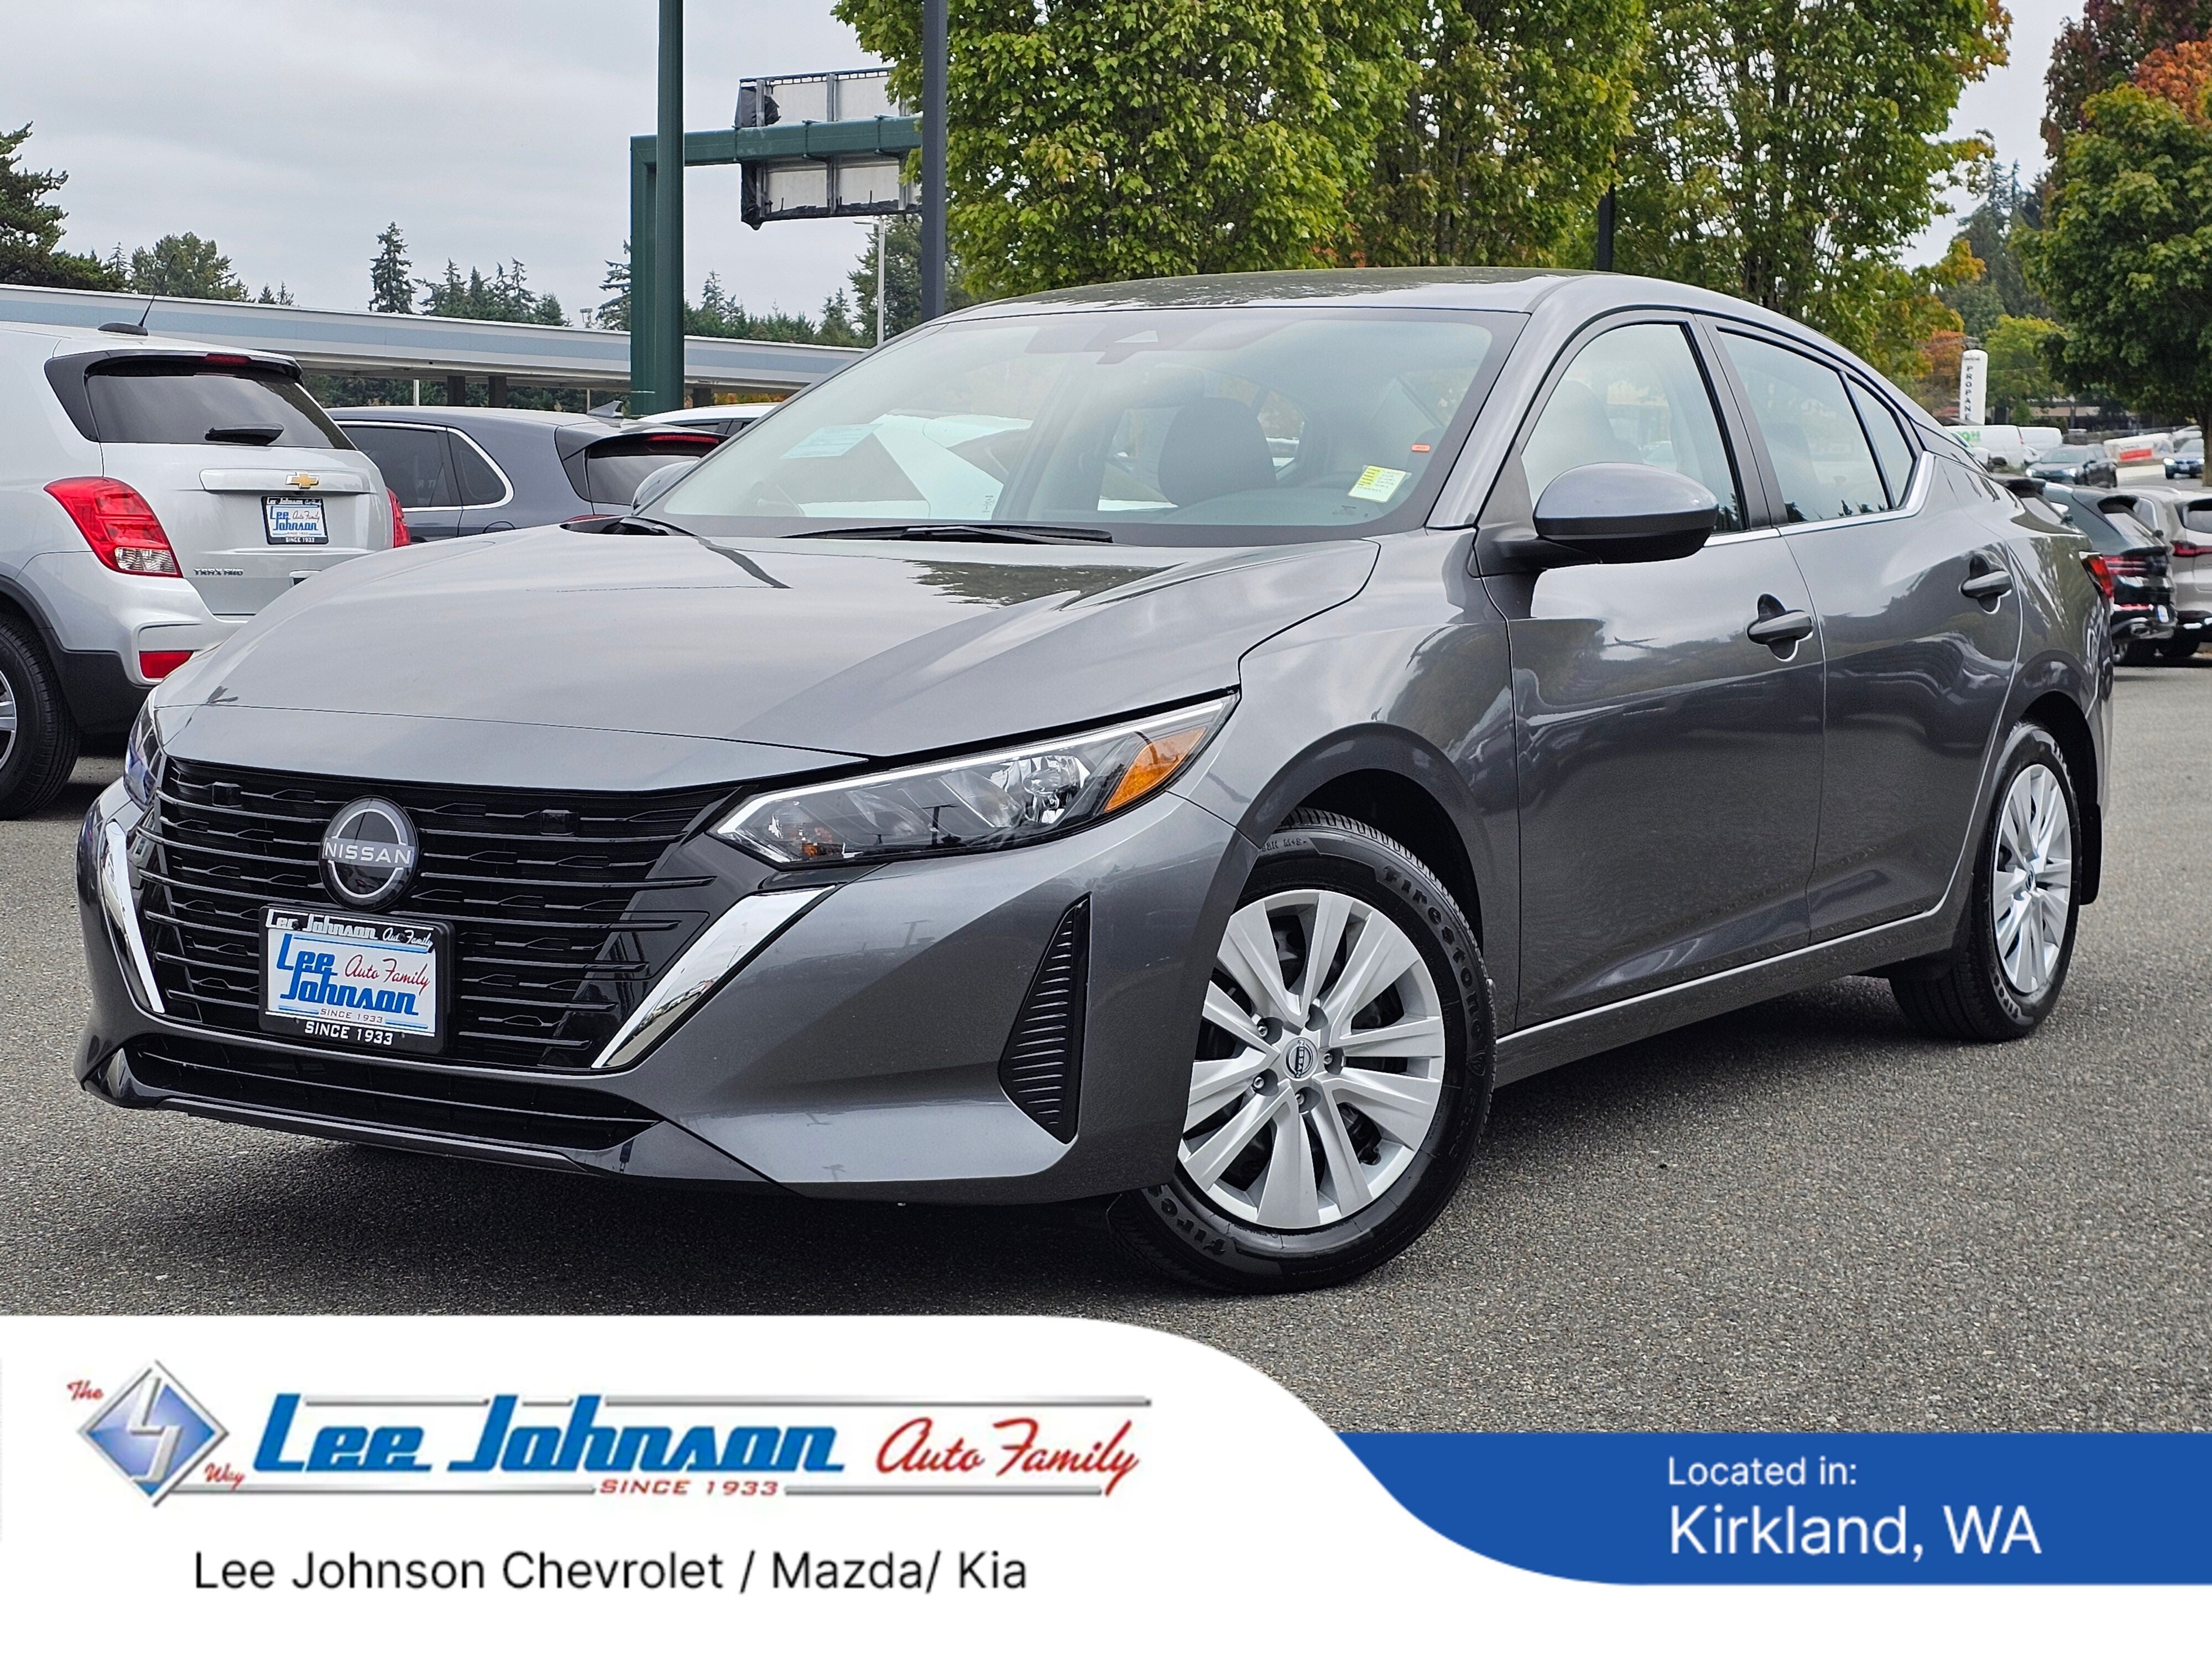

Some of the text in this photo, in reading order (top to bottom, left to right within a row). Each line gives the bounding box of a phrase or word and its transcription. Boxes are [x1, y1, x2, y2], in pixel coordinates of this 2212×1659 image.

[1965, 366, 1973, 420] PROPANE
[270, 505, 291, 519] Lee
[273, 518, 318, 530] Johnson
[324, 841, 411, 864] NISSAN
[302, 914, 378, 940] Johnson
[383, 927, 405, 942] Aut
[404, 930, 433, 952] Family
[276, 933, 430, 996] Lee Auto Family
[280, 972, 419, 1016] Johnson
[320, 1008, 383, 1024] SINCE 1933
[305, 1020, 394, 1045] SINCE 1933
[1296, 1040, 1304, 1078] NISSAN
